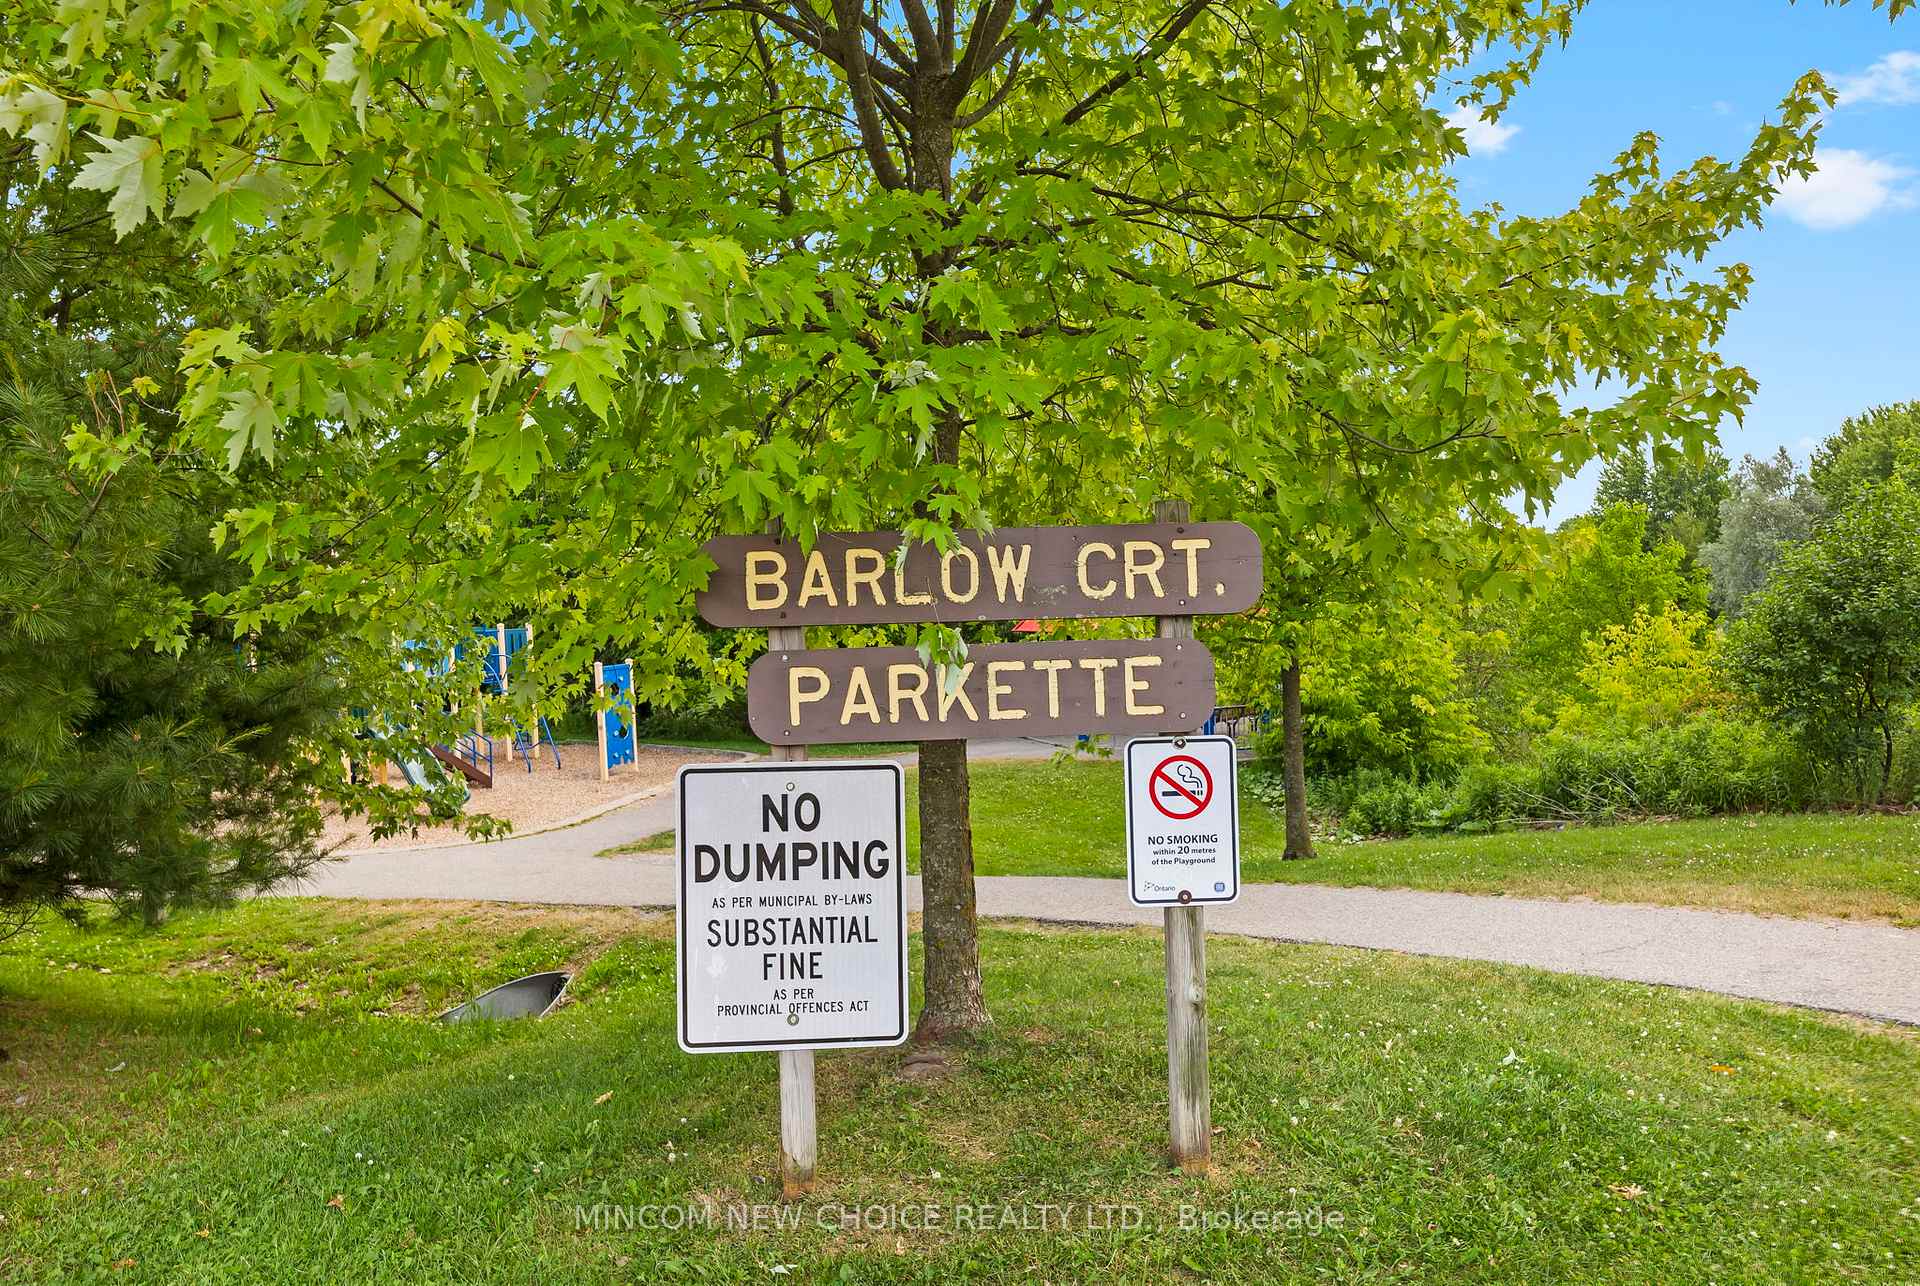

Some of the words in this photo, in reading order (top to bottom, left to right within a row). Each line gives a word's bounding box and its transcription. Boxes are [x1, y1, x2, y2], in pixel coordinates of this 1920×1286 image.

[745, 543, 1032, 611] BARLOW
[1078, 538, 1226, 600] CRT.
[789, 656, 1164, 726] PARKETTE
[762, 792, 821, 832] NO
[1148, 836, 1164, 845] NO
[1167, 834, 1218, 844] SMOKING
[1177, 846, 1189, 854] 20
[694, 840, 889, 883] DUMPING
[1174, 857, 1215, 865] Playground
[712, 897, 726, 908] AS
[732, 897, 752, 907] PER
[760, 895, 818, 907] MUNICIPAL
[825, 894, 872, 905] BY-LAWS
[707, 916, 878, 947] SUBSTANTIAL
[763, 952, 823, 981] FINE
[774, 990, 787, 1000] AS
[794, 989, 814, 999] PER
[717, 1004, 782, 1016] PROVINCIAL
[788, 1002, 843, 1014] OFFENCES
[850, 1001, 869, 1011] ACT
